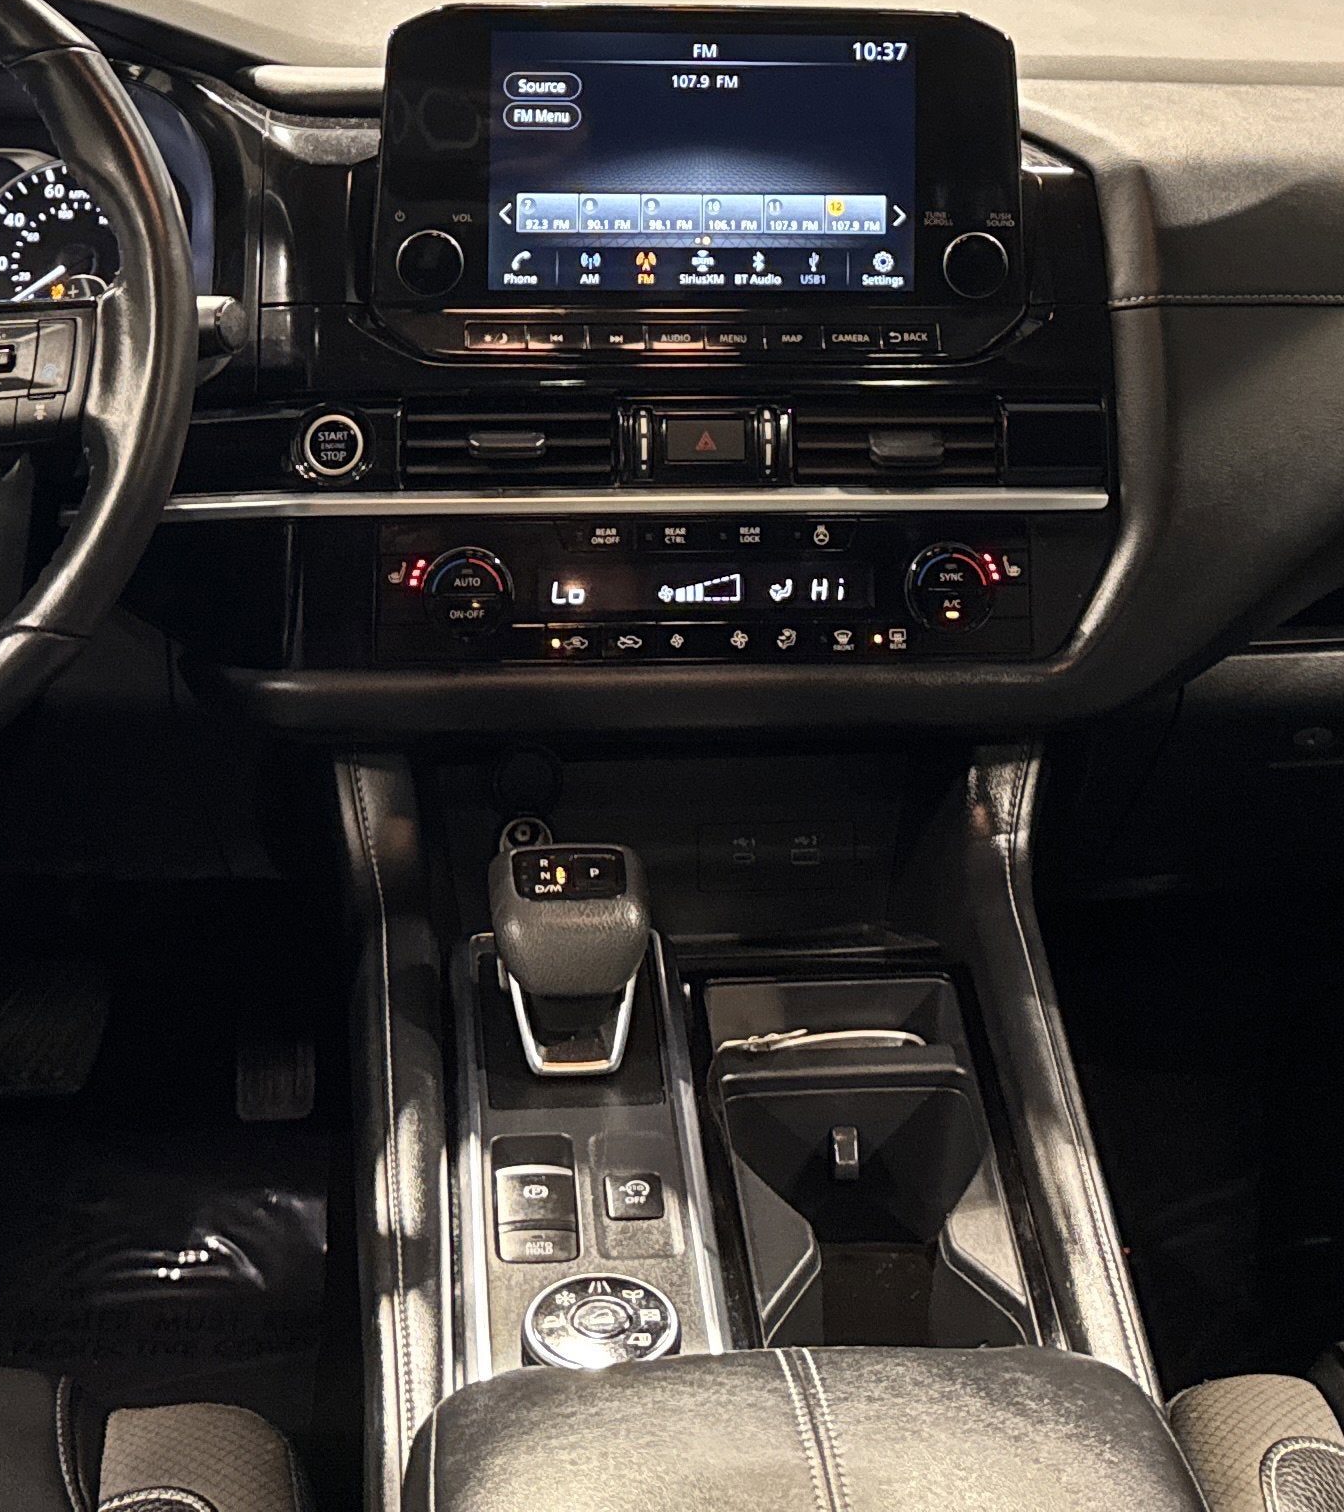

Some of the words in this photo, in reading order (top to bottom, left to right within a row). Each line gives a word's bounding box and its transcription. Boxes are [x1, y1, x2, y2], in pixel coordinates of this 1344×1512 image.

[692, 44, 718, 58] FM
[852, 42, 908, 62] 10:37
[518, 79, 566, 94] Source
[671, 74, 710, 89] 107.9
[716, 74, 739, 89] FM
[513, 109, 534, 123] FM
[535, 109, 570, 124] Menu
[44, 184, 65, 199] 60
[524, 200, 532, 211] 7
[585, 200, 594, 211] 8
[648, 201, 656, 211] 9
[707, 201, 720, 212] 10
[768, 201, 781, 212] 11
[830, 201, 843, 212] 12
[3, 212, 26, 227] 40
[452, 213, 472, 223] VOL
[553, 219, 570, 230] FM
[615, 219, 631, 230] FM
[676, 219, 693, 231] FM
[741, 220, 758, 231] FM
[770, 220, 798, 232] 107.9
[802, 220, 819, 231] FM
[831, 220, 860, 232] 107.9
[864, 220, 881, 232] FM
[503, 273, 538, 285] Phone
[579, 273, 600, 285] AM
[637, 273, 655, 285] FM
[679, 273, 725, 285] SiriusXM
[734, 274, 748, 285] BT
[750, 273, 782, 285] Audio
[800, 274, 826, 285] USB1
[861, 273, 904, 288] Settings
[660, 333, 691, 342] AUDIO
[719, 334, 747, 343] MENU
[781, 334, 803, 343] MAP
[831, 333, 870, 343] CAMERA
[903, 332, 928, 342] BACK
[317, 431, 348, 441] START
[320, 442, 345, 450] ENGINE
[320, 451, 347, 461] STOP
[595, 527, 617, 536] REAR
[664, 527, 686, 535] REAR
[739, 526, 761, 535] REAR
[665, 536, 686, 544] CTRL
[739, 535, 761, 543] LOCK
[454, 577, 481, 587] AUTO
[939, 572, 964, 582] SYNC
[551, 581, 586, 604] Lo
[811, 578, 845, 601] Hi
[943, 599, 962, 608] A/C
[539, 859, 549, 868] R
[540, 871, 551, 880] N
[589, 868, 600, 878] P
[535, 884, 563, 894] D/M
[625, 1196, 647, 1205] OFF
[525, 1241, 553, 1249] AUTO
[525, 1247, 553, 1255] HOLD
